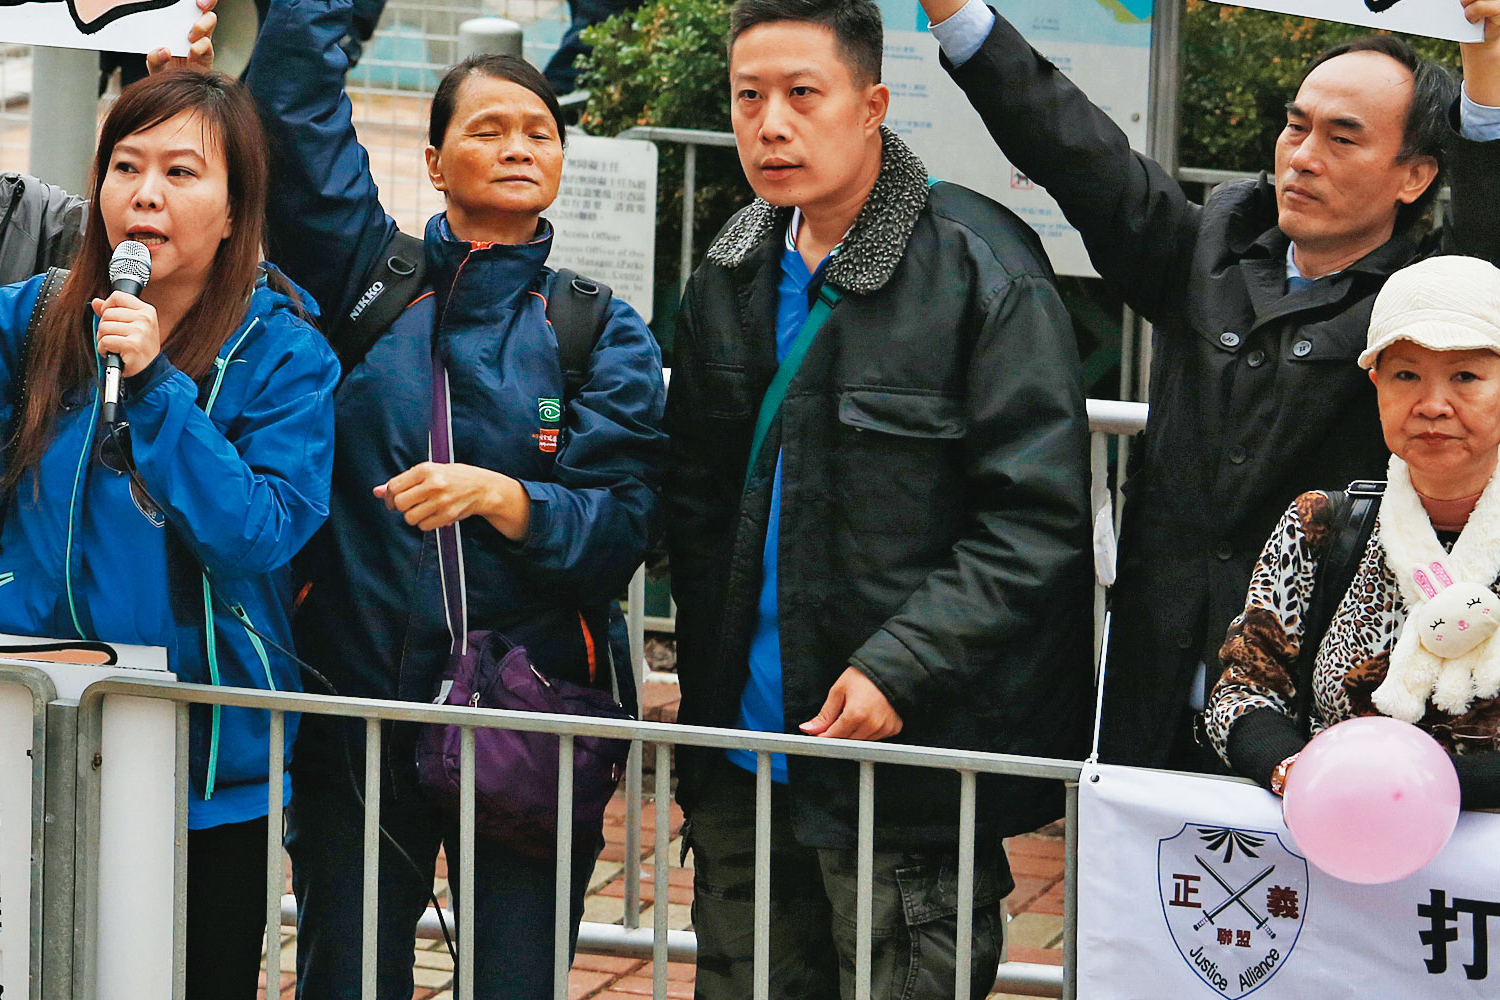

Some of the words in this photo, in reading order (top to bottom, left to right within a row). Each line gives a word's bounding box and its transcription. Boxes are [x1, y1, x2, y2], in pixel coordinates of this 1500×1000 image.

[350, 281, 384, 321] NIKKO
[1189, 946, 1228, 991] Justice
[1238, 948, 1280, 992] Alliance
